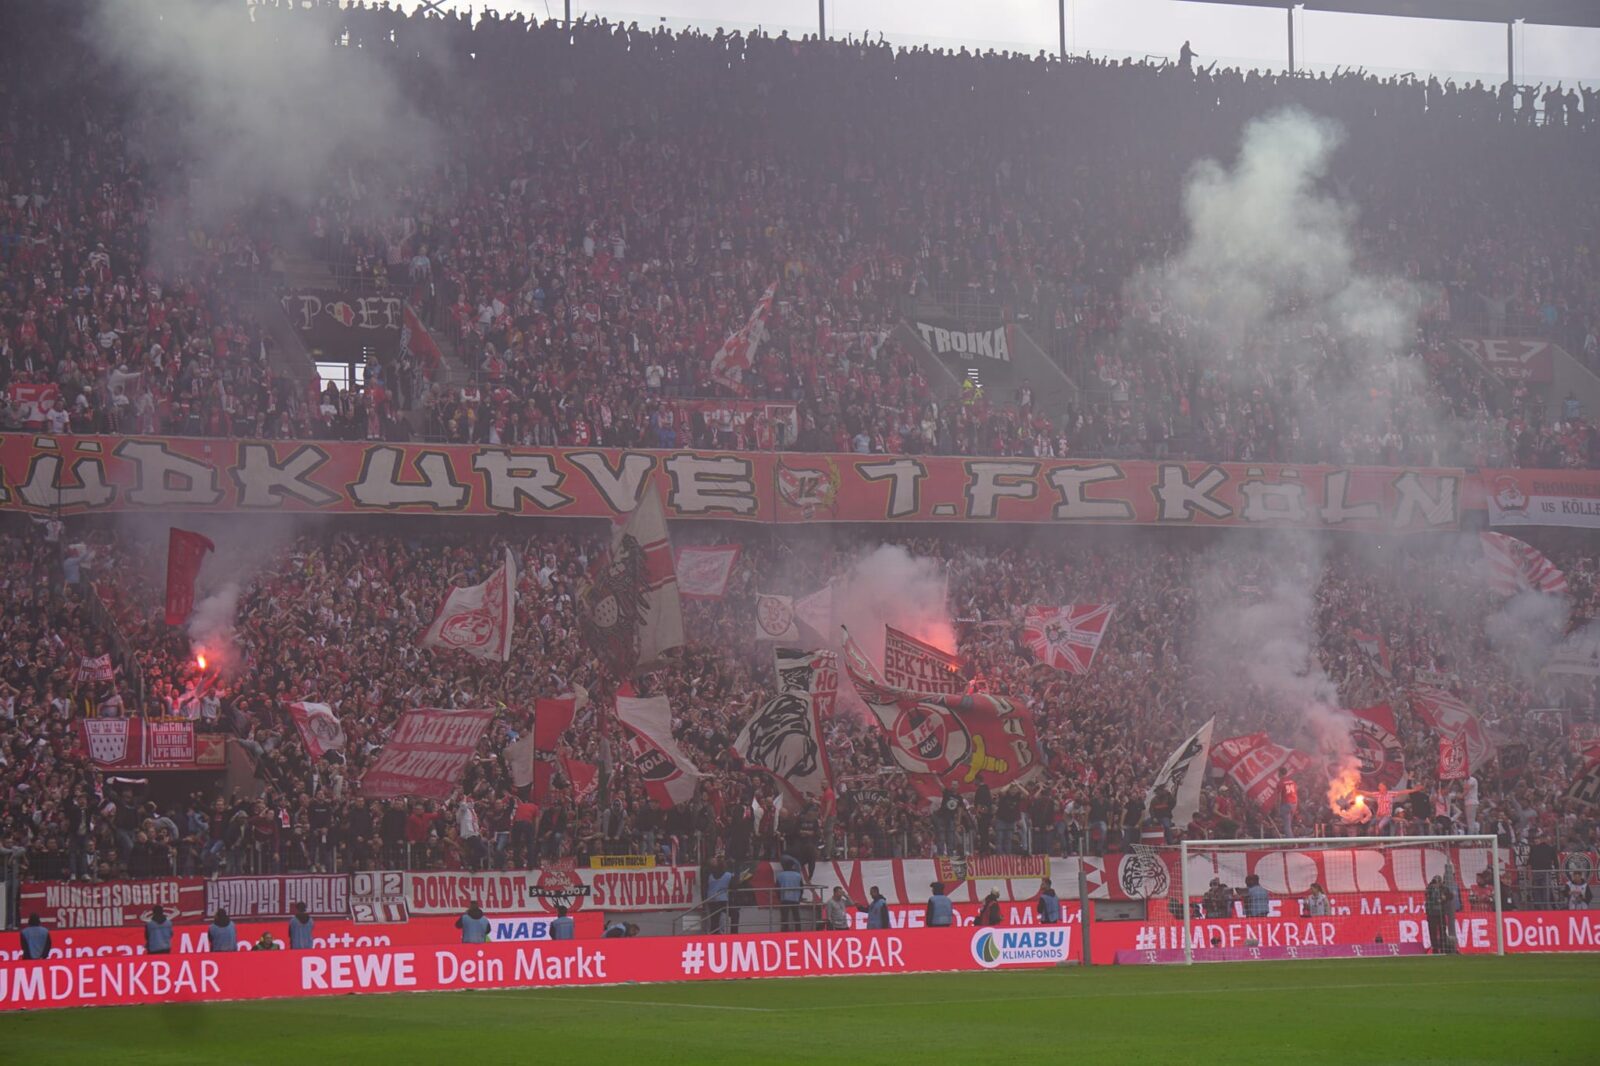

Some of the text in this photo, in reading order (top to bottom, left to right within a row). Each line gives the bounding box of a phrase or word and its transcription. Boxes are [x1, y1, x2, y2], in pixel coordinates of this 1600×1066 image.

[916, 321, 1010, 362] TROIKA
[0, 437, 758, 514] ÜDKURVE
[1152, 463, 1459, 527] KÖLN
[966, 855, 1047, 877] STADIONVERBOT
[46, 882, 180, 908] MÜNGERSDORFER
[207, 877, 347, 916] SEMPER FIDELIS
[411, 876, 527, 909] DOMSTADT
[57, 907, 124, 928] STADION
[496, 921, 547, 940] NAB
[1504, 918, 1560, 947] Dein
[1002, 930, 1065, 949] NABU
[1002, 948, 1063, 960] KLIMAFONDS
[301, 946, 607, 990] REWE Dein Markt
[681, 936, 905, 975] #UMDENKBAR
